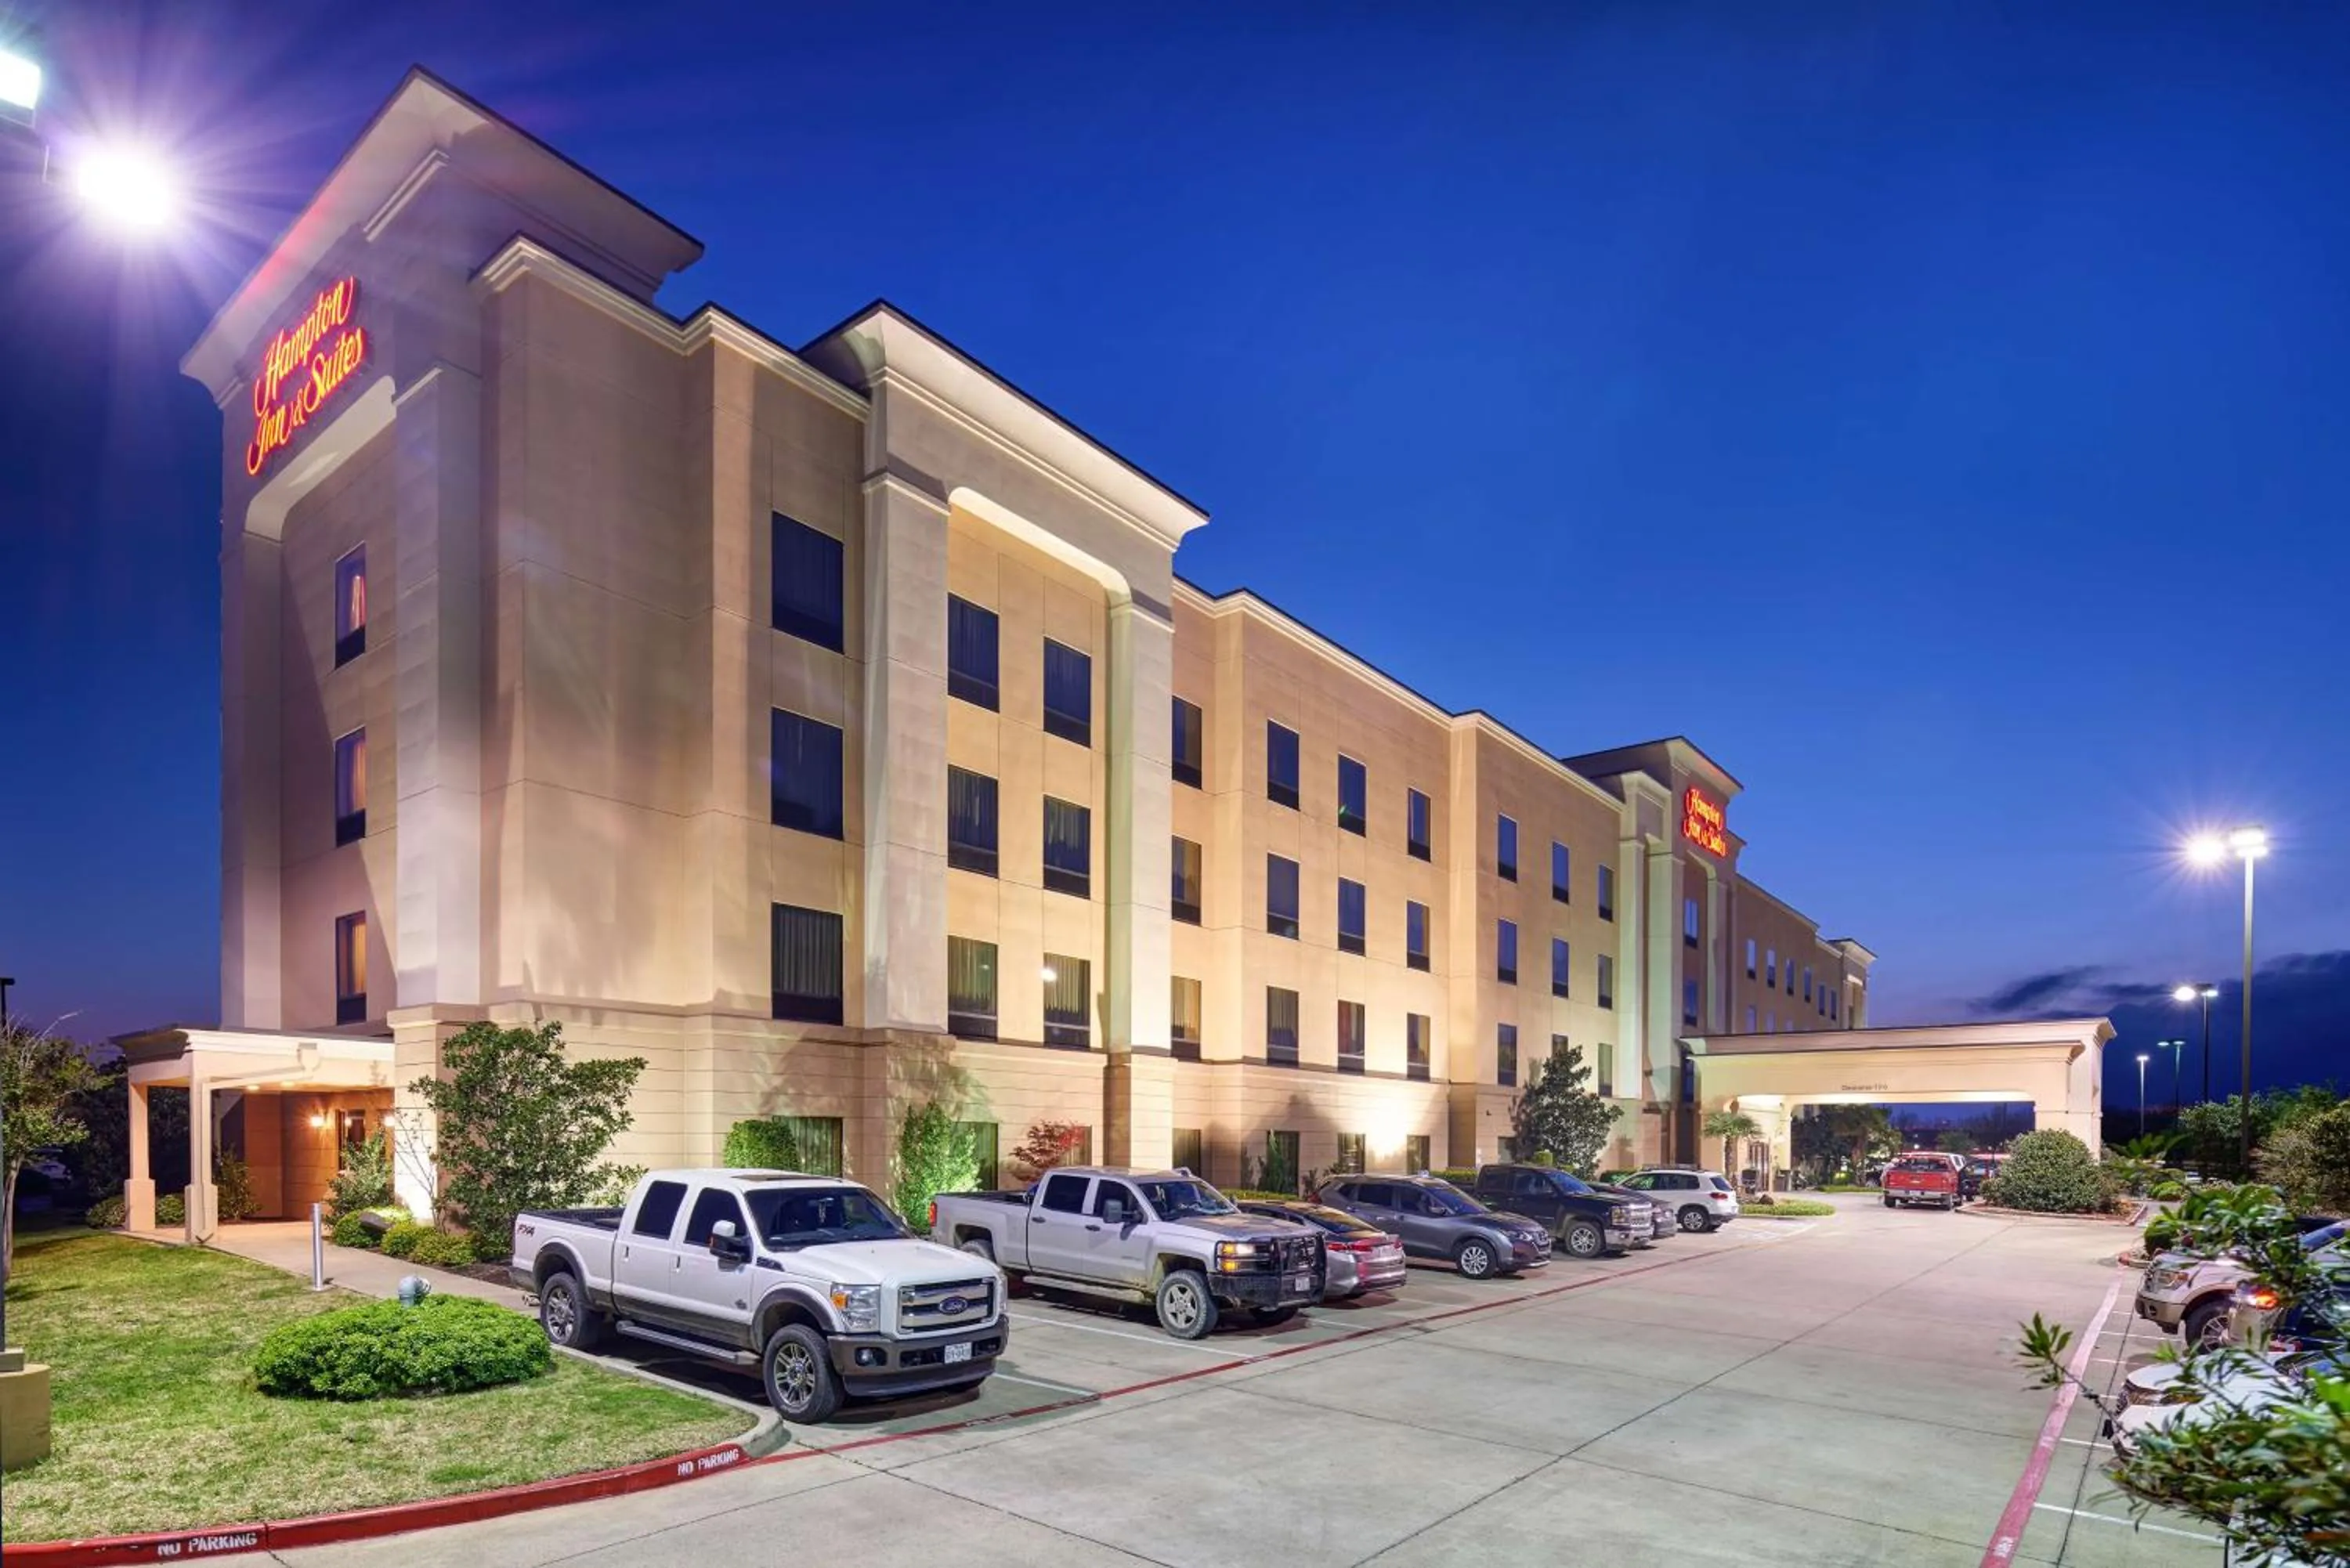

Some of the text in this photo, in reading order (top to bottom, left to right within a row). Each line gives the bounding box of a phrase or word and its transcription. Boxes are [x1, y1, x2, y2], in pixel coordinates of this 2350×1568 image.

[255, 276, 354, 417] Hampton
[247, 404, 294, 475] Inn
[304, 327, 363, 413] Suites
[678, 1448, 739, 1476] NO PARKING
[188, 1533, 258, 1552] PARKING
